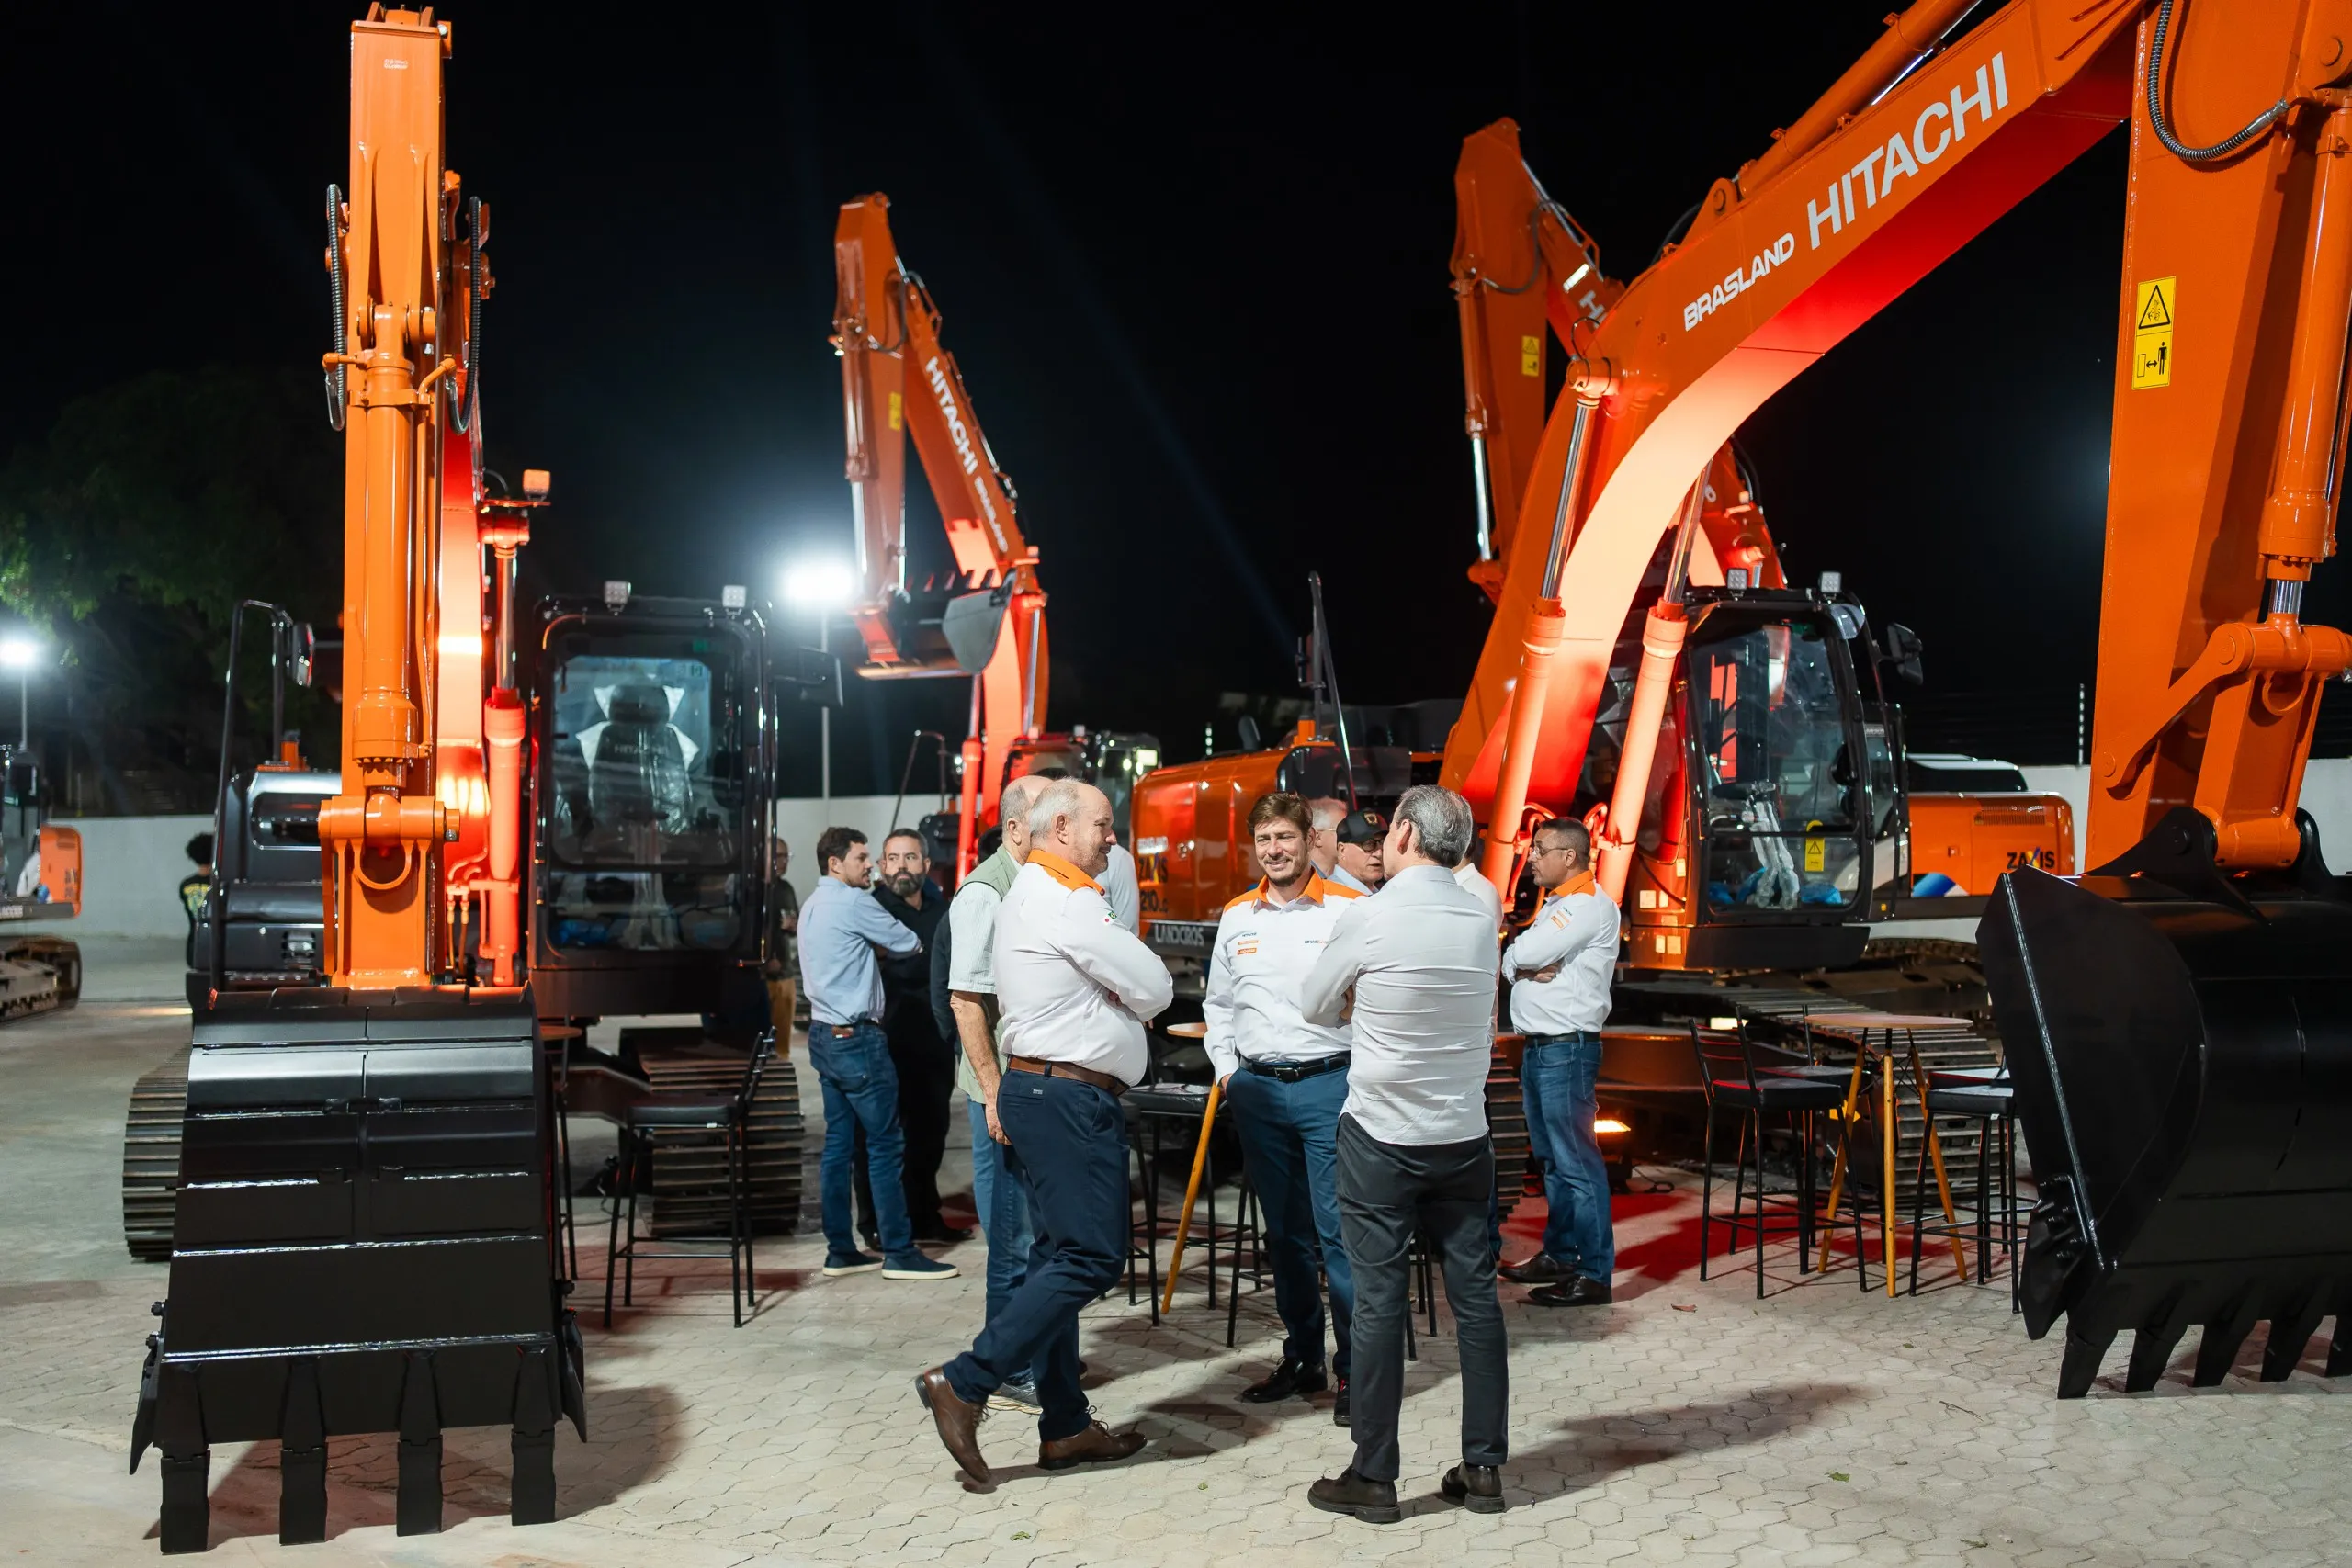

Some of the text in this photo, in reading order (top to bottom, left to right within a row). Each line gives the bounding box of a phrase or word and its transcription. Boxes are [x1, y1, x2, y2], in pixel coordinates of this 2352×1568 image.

[1683, 51, 2009, 332] BRASLAND HITACHI
[925, 355, 979, 476] HITACHI
[2006, 847, 2055, 870] ZAXIS
